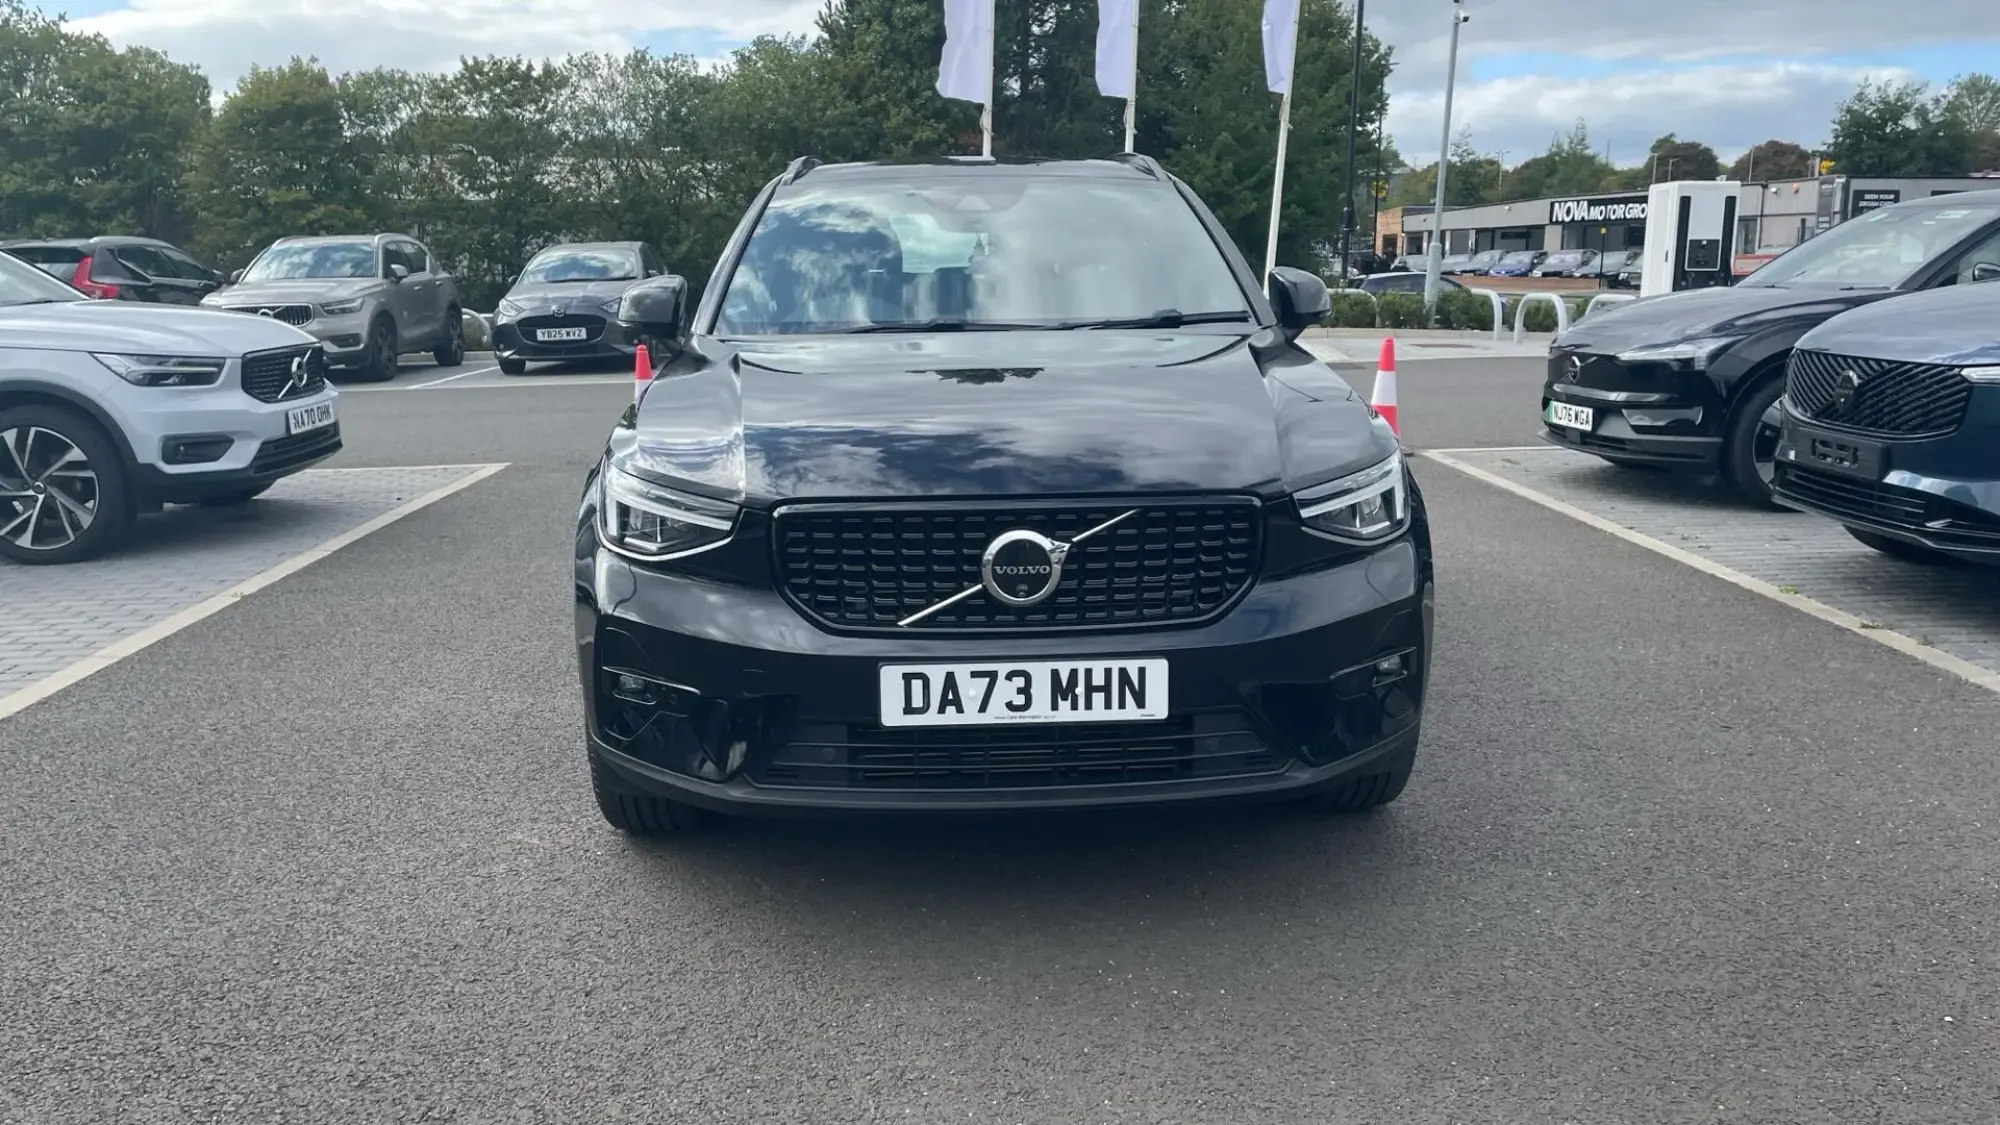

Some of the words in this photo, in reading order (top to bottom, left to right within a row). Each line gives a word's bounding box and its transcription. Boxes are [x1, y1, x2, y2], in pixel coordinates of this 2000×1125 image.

[1552, 200, 1589, 222] NOVA
[292, 408, 316, 430] NA70
[993, 565, 1050, 575] VOLVO
[902, 669, 1033, 715] DA73
[1050, 666, 1147, 711] MHN
